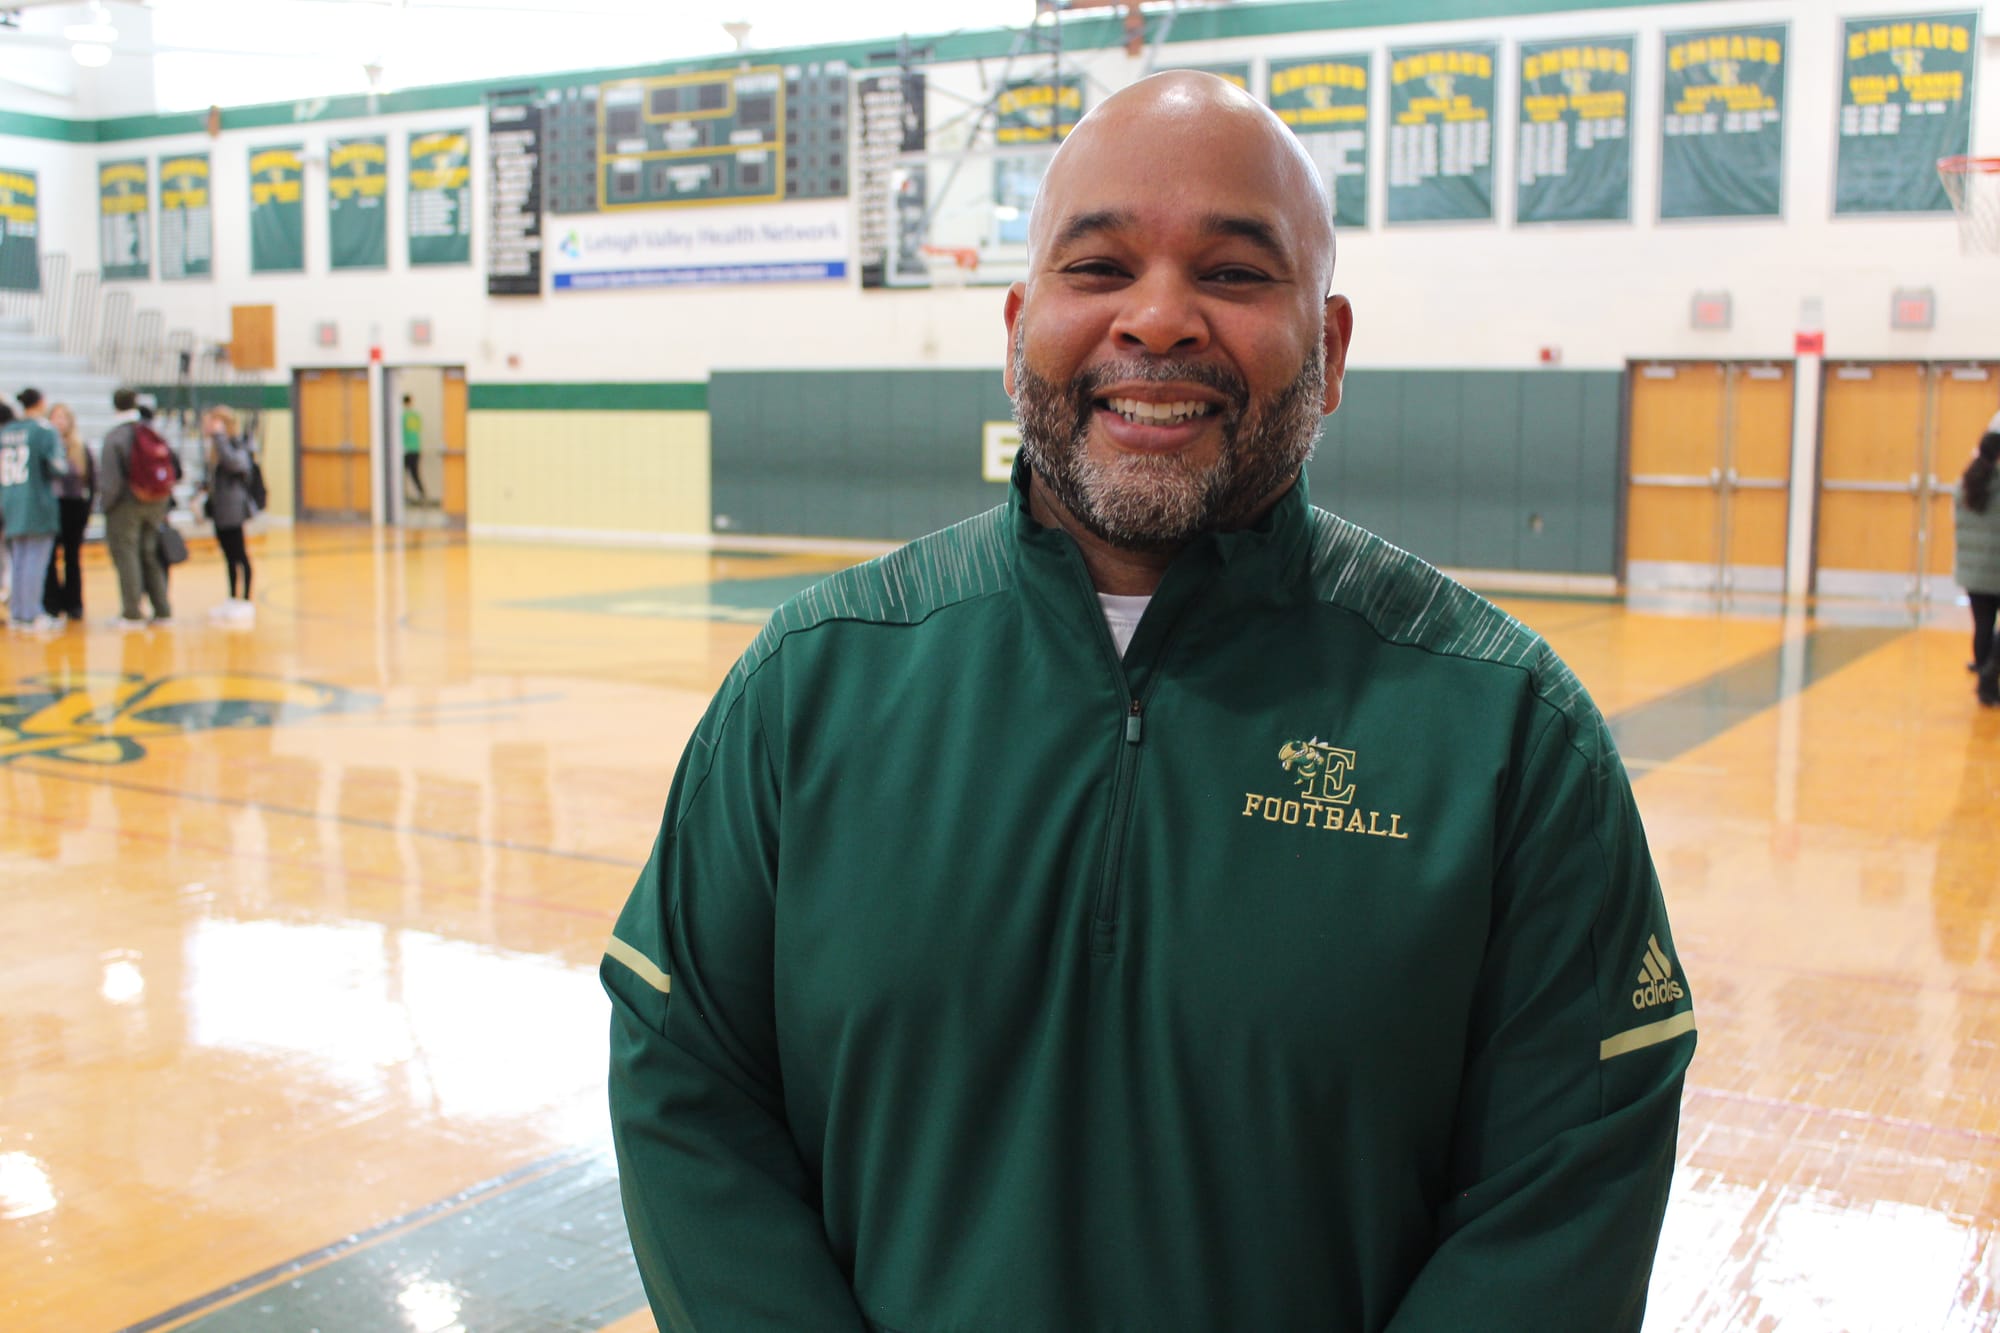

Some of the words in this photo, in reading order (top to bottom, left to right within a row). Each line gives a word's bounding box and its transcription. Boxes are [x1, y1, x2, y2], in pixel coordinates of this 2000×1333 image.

[1669, 35, 1780, 71] EMMAUS
[1848, 22, 1968, 60] EMMAUS
[1242, 792, 1409, 840] FOOTBALL
[1632, 977, 1685, 1011] adidas
